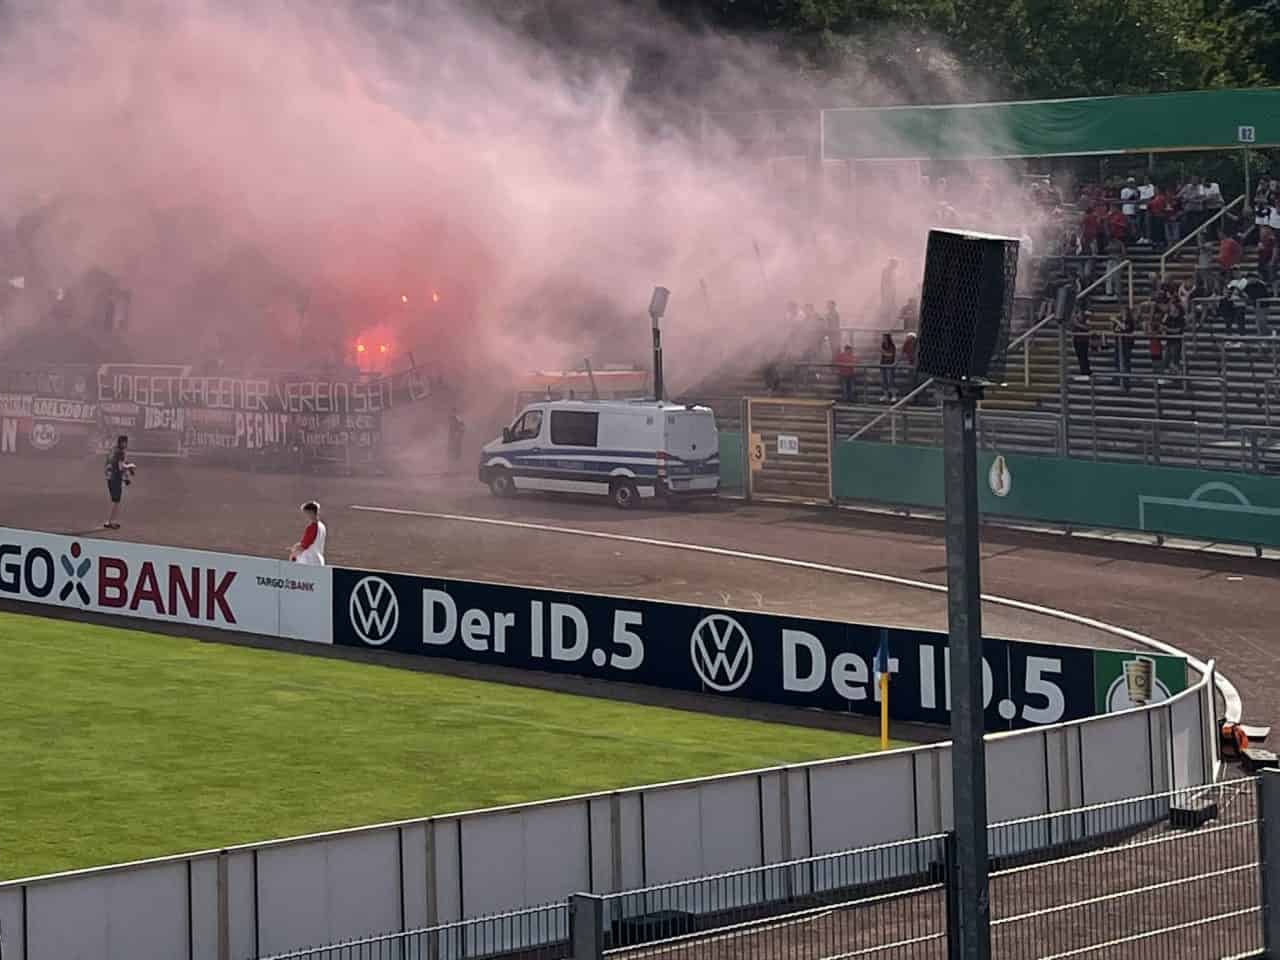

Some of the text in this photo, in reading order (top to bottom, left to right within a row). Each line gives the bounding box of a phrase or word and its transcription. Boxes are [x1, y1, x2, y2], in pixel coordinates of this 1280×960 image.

[422, 588, 644, 670] Der ID.5
[782, 628, 899, 702] Der
